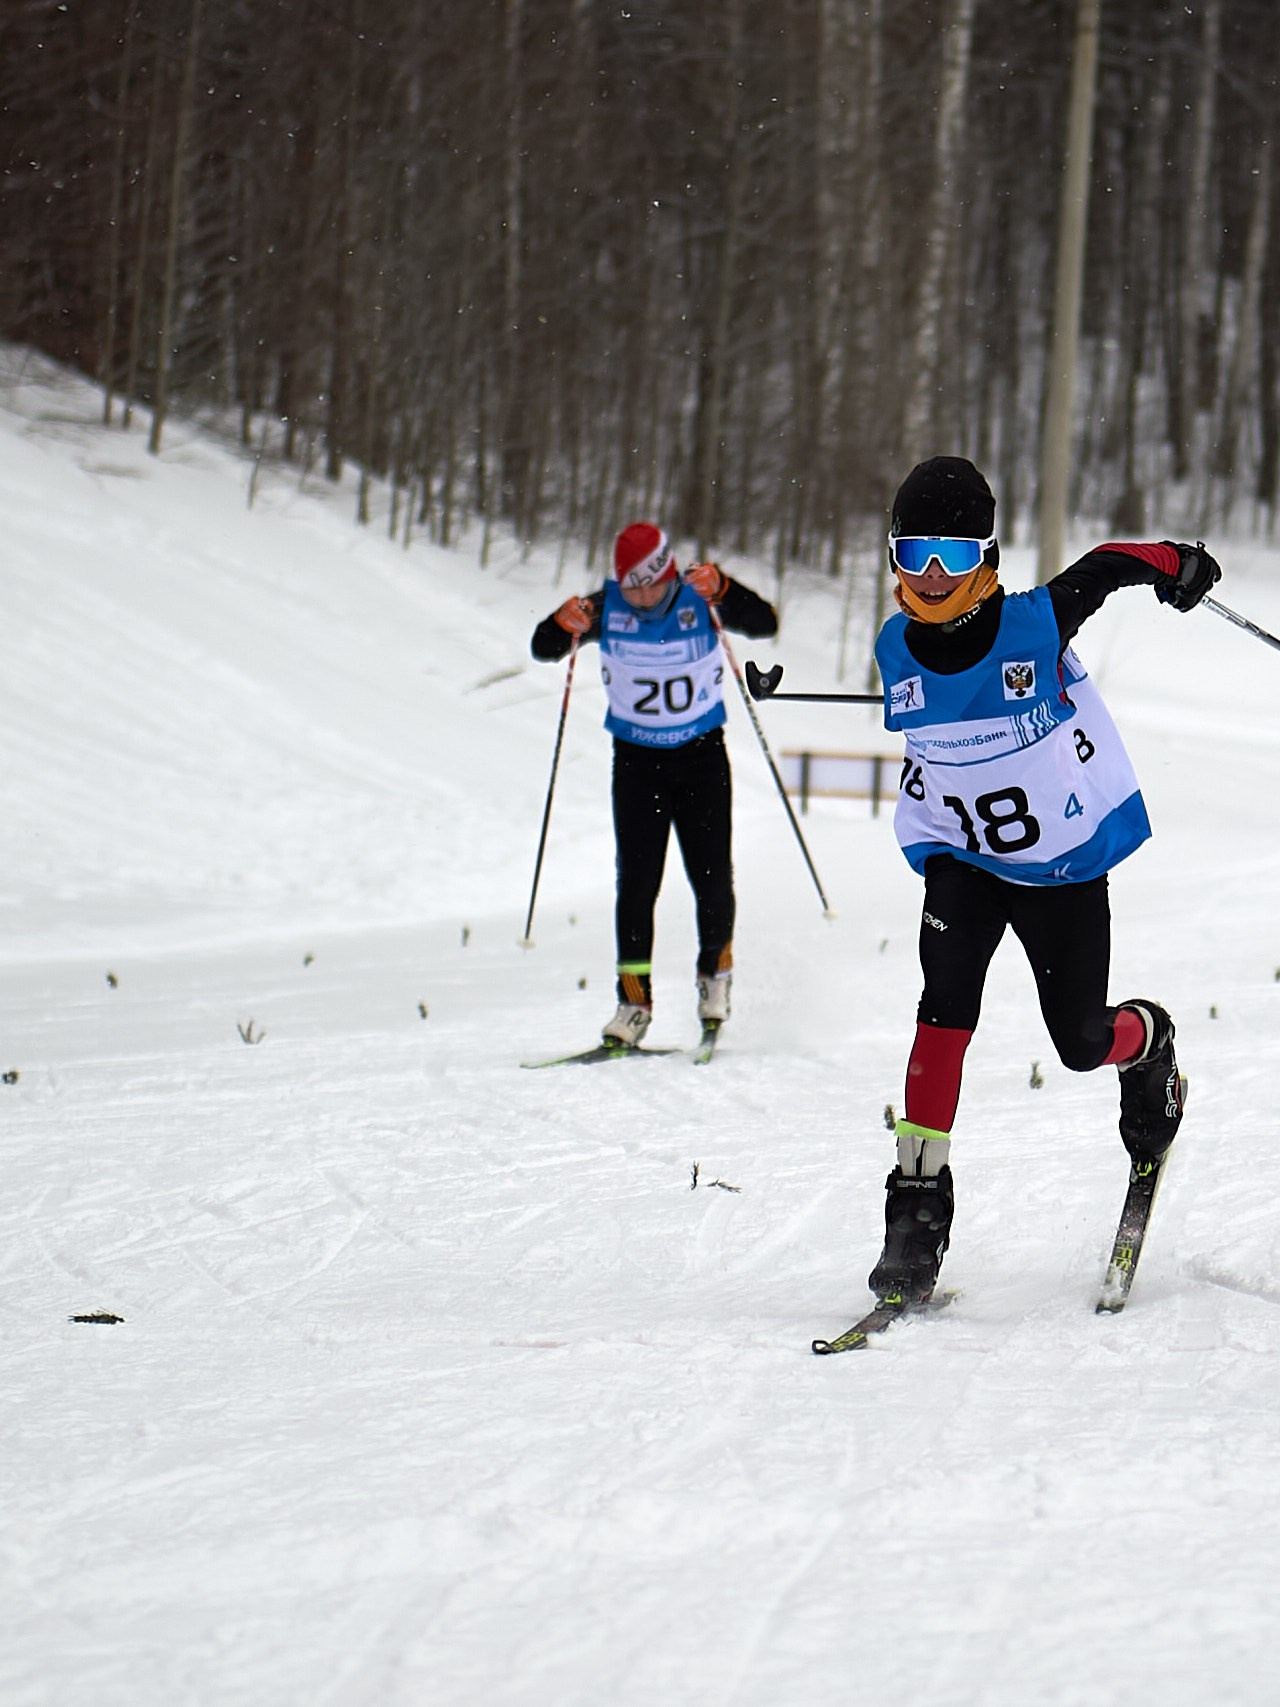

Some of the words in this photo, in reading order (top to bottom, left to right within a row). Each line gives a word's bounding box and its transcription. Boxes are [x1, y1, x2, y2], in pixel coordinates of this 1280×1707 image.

[632, 676, 694, 716] 20
[943, 786, 1041, 854] 18
[1064, 792, 1084, 819] 4
[1165, 1052, 1177, 1118] SPIN
